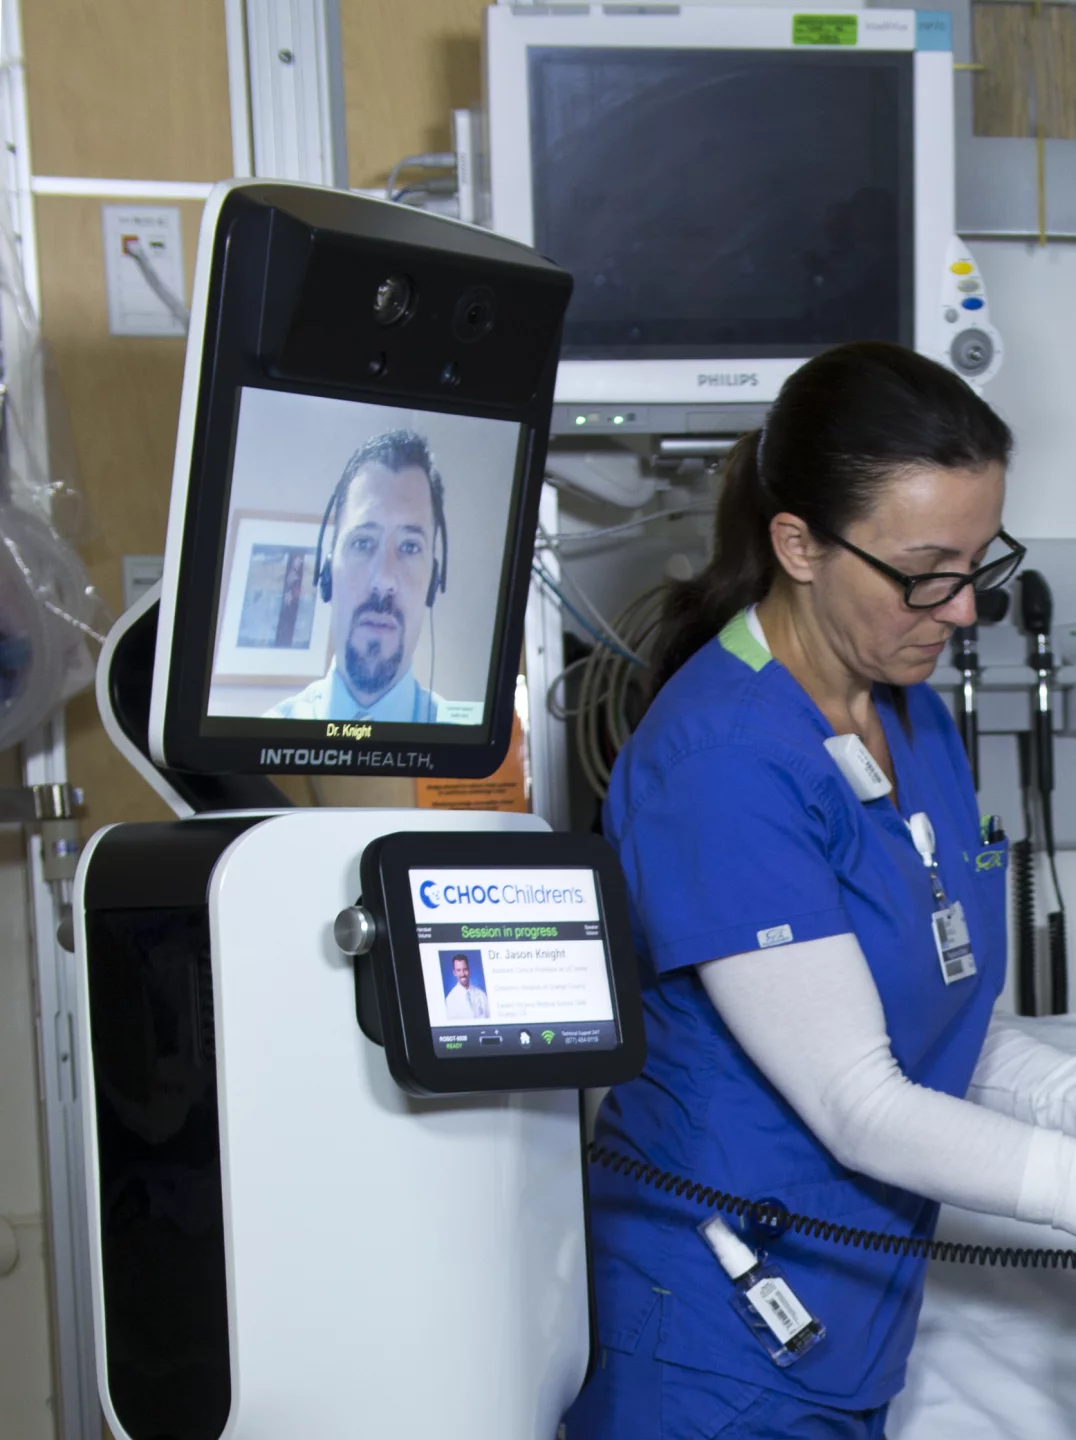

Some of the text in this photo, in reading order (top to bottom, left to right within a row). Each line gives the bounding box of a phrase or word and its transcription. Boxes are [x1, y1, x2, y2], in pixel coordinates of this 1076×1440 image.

[697, 373, 760, 387] PHILIPS
[326, 723, 372, 740] Dr. Knight
[260, 749, 352, 766] INTOUCH
[443, 884, 583, 905] CHOC Children's
[461, 925, 558, 939] Session in progress
[488, 949, 566, 961] Dr. Jason Knight
